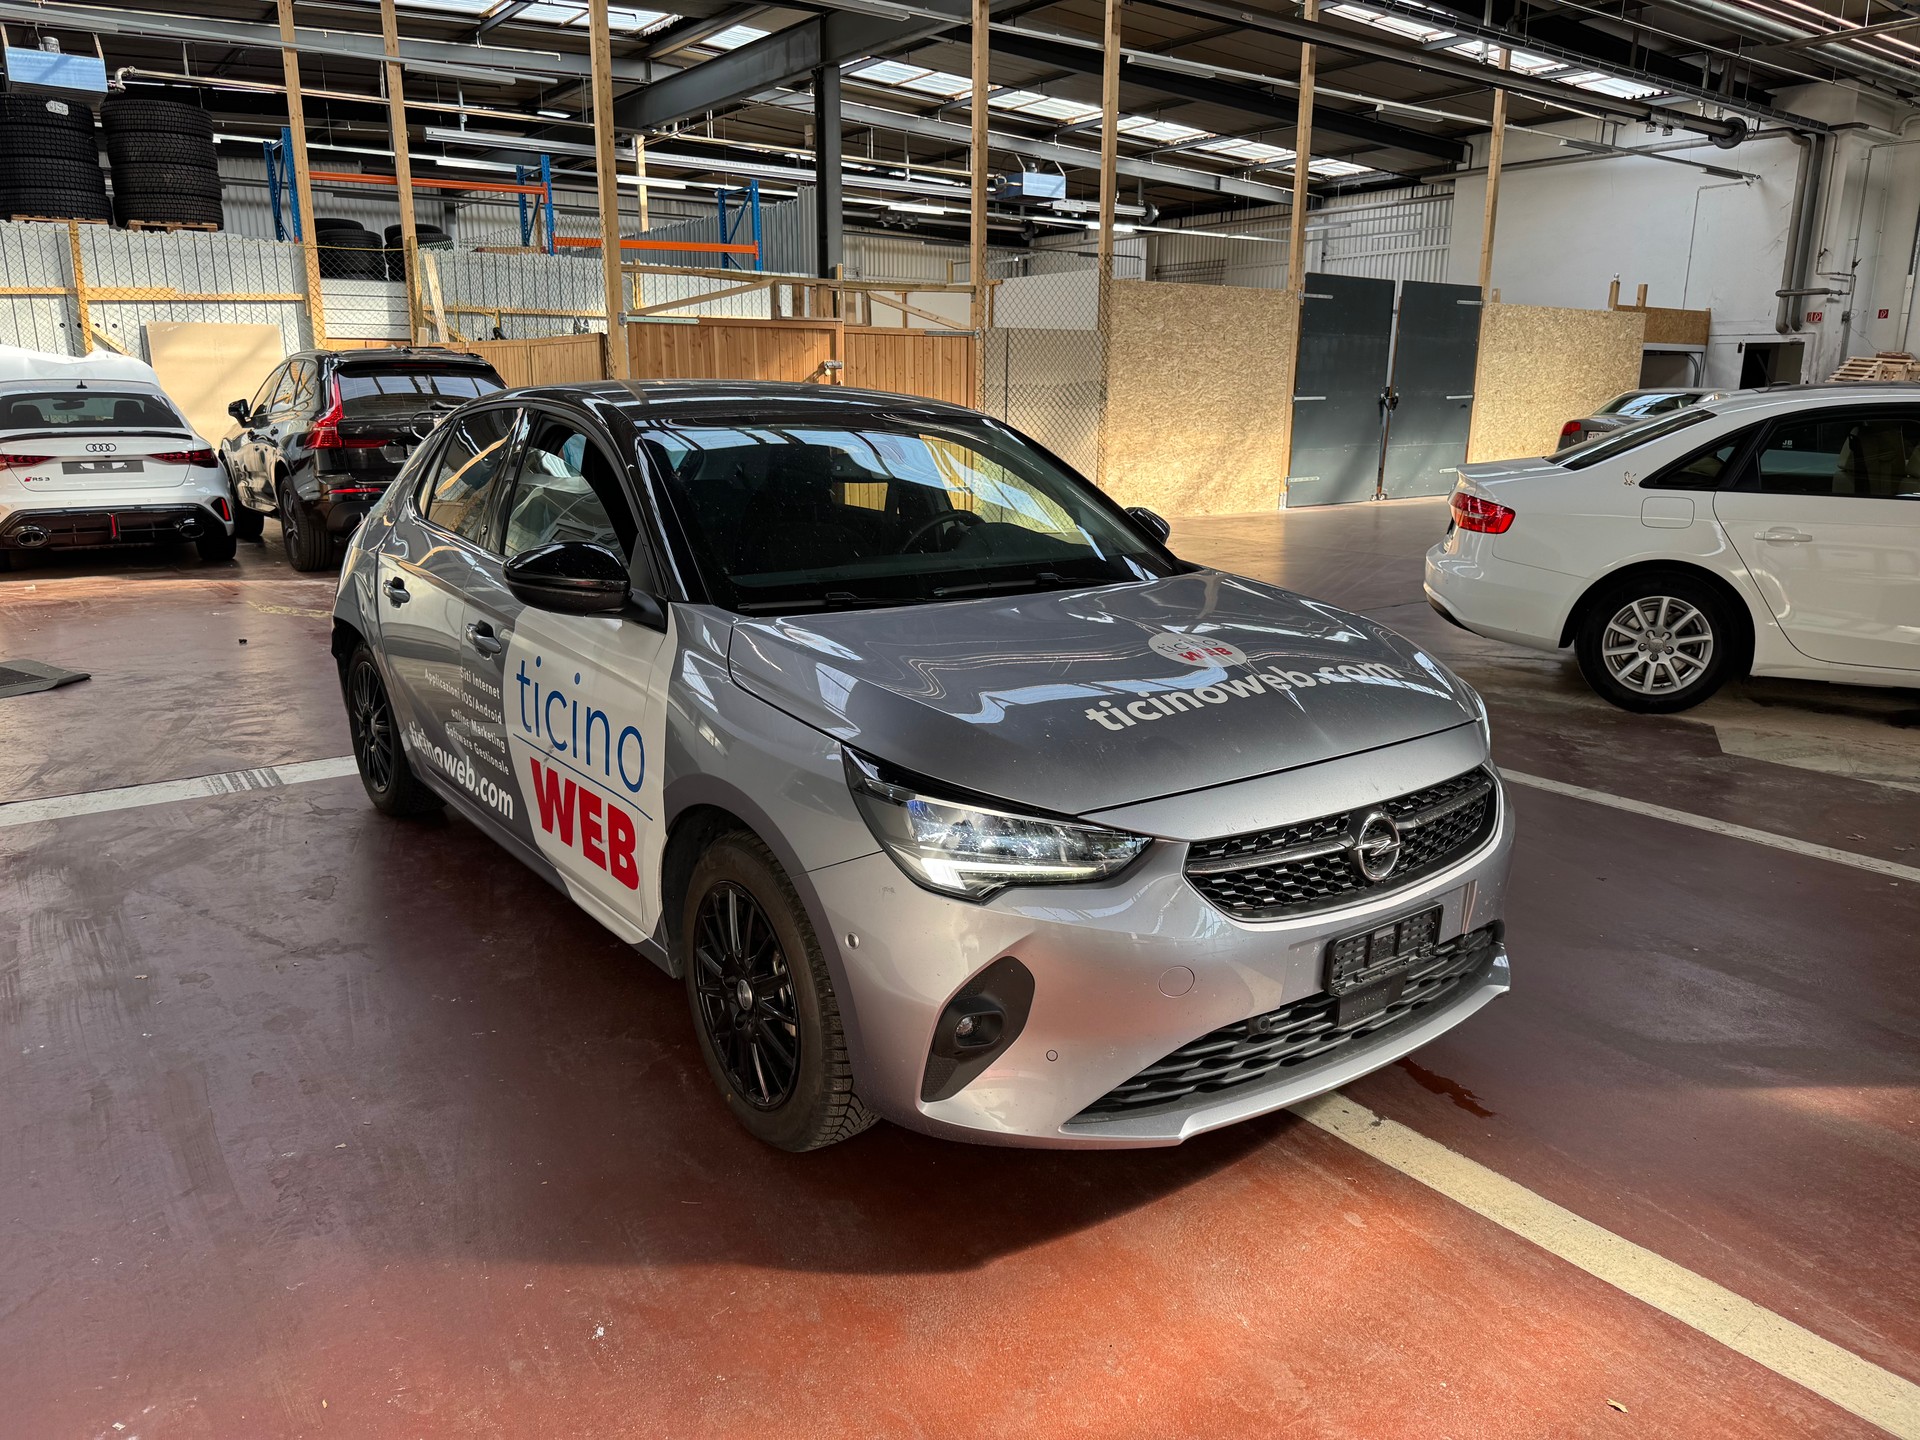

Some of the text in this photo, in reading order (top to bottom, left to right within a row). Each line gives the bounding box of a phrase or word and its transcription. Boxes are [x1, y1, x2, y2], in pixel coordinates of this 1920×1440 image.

[1177, 647, 1233, 661] WEB
[425, 668, 460, 700] Applicazioni
[460, 666, 501, 699] Siti Internet
[1084, 661, 1405, 731] ticinoweb.com
[445, 722, 510, 776] Software Gestionale
[471, 719, 506, 754] Marketing
[516, 655, 645, 793] ticino
[408, 720, 514, 821] ticinoweb.com
[529, 756, 640, 891] WEB
